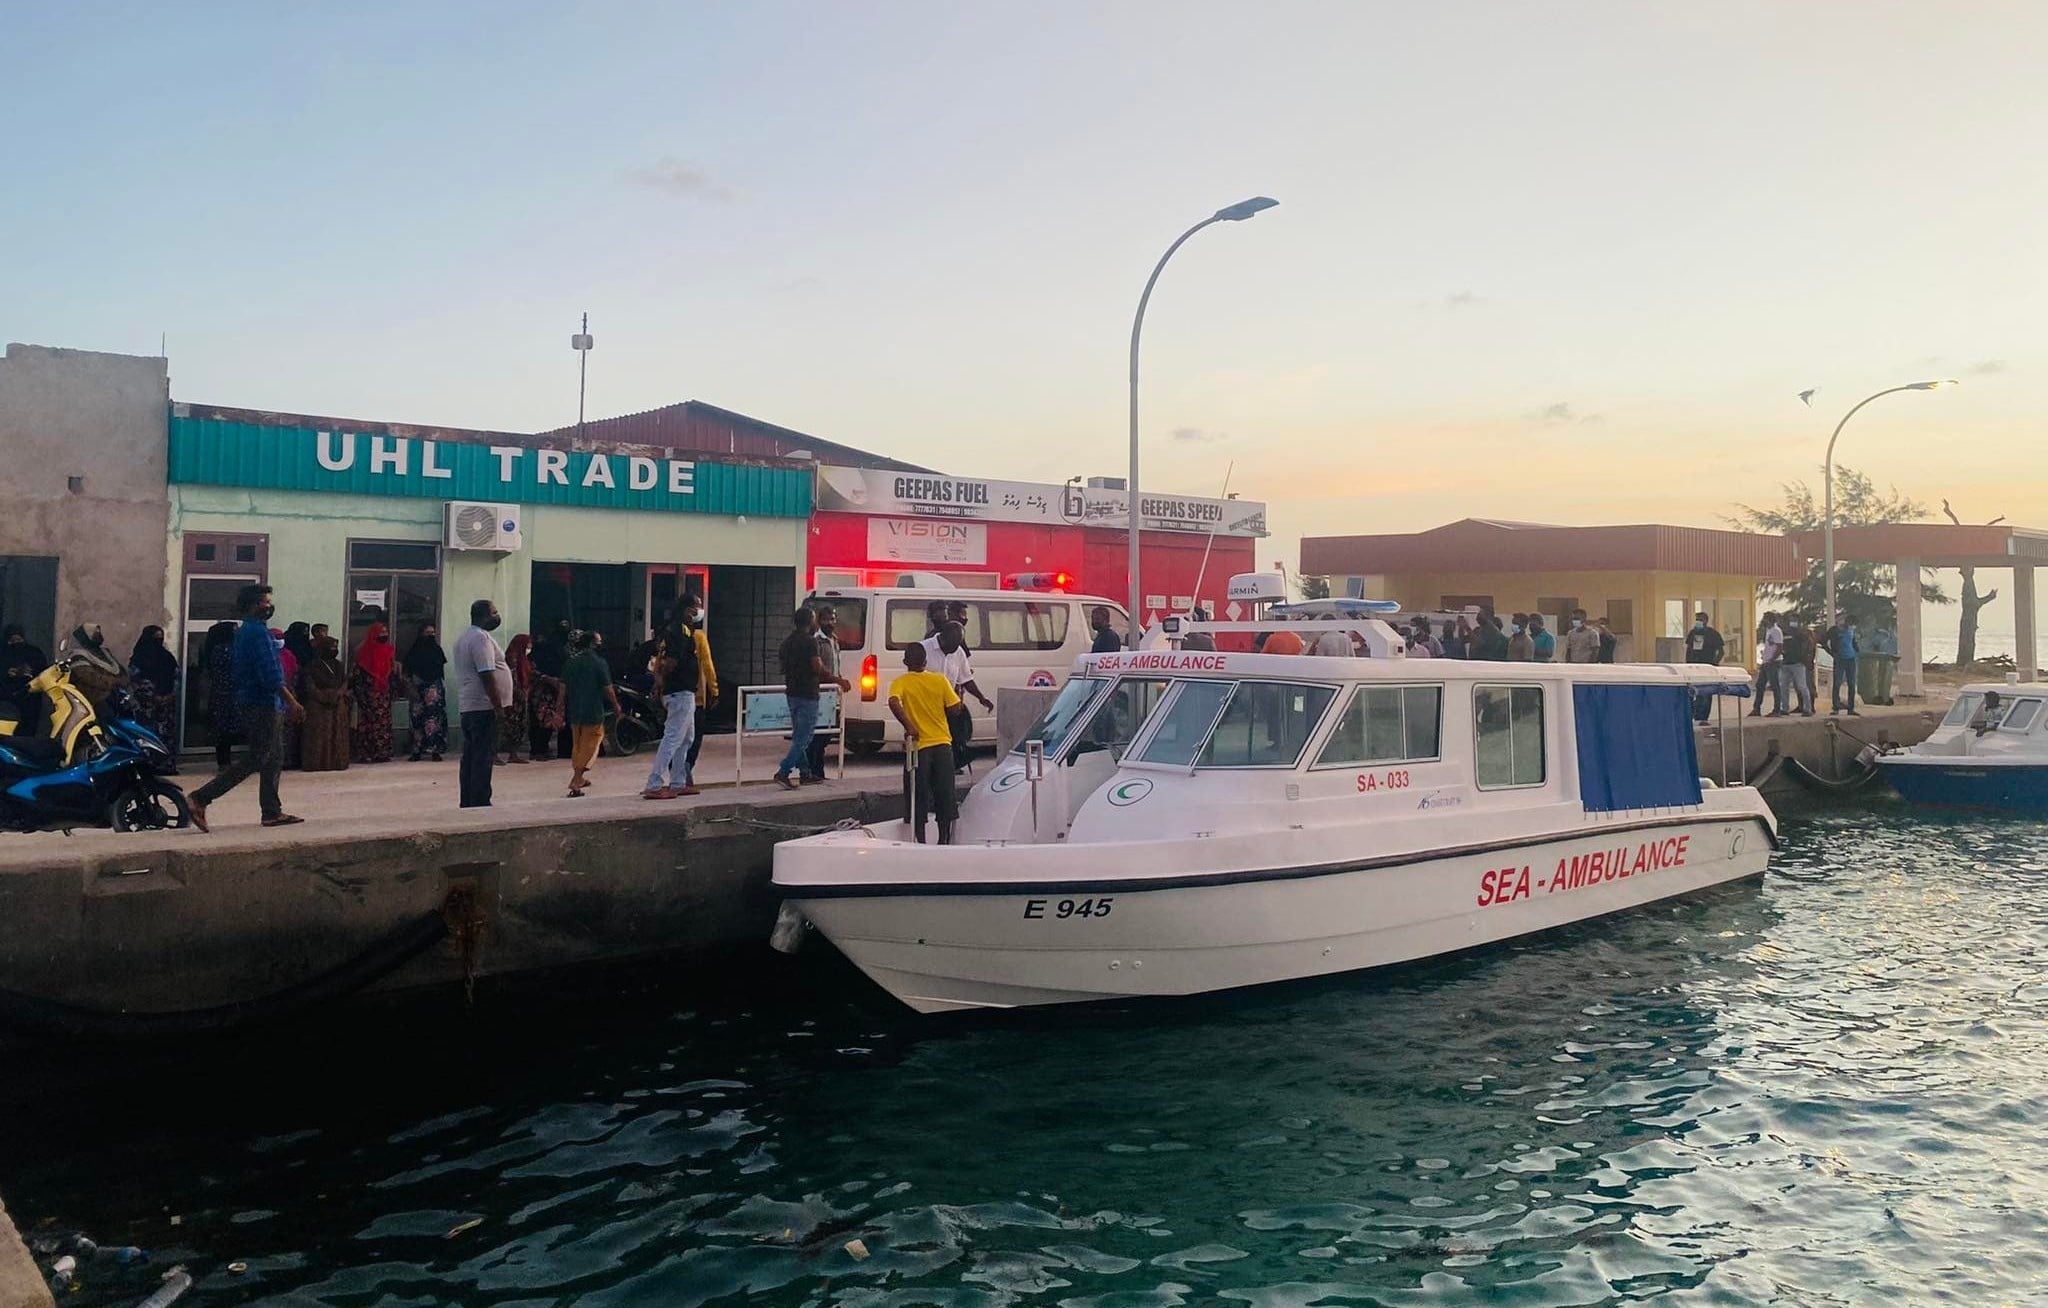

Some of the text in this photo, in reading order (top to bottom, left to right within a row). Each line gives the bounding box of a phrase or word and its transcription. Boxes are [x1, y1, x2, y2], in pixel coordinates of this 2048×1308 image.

[317, 432, 694, 494] UHL TRADE
[894, 477, 988, 504] GEEPAS FUEL
[1141, 498, 1185, 518] GEEPAS
[888, 521, 967, 537] VISION
[1098, 656, 1119, 669] SEA
[1129, 656, 1226, 670] AMBULANCE
[1357, 774, 1376, 792] SA
[1387, 771, 1409, 788] 033
[1477, 866, 1530, 907] SEA
[1549, 836, 1690, 893] AMBULANCE
[1024, 897, 1113, 919] E 945
